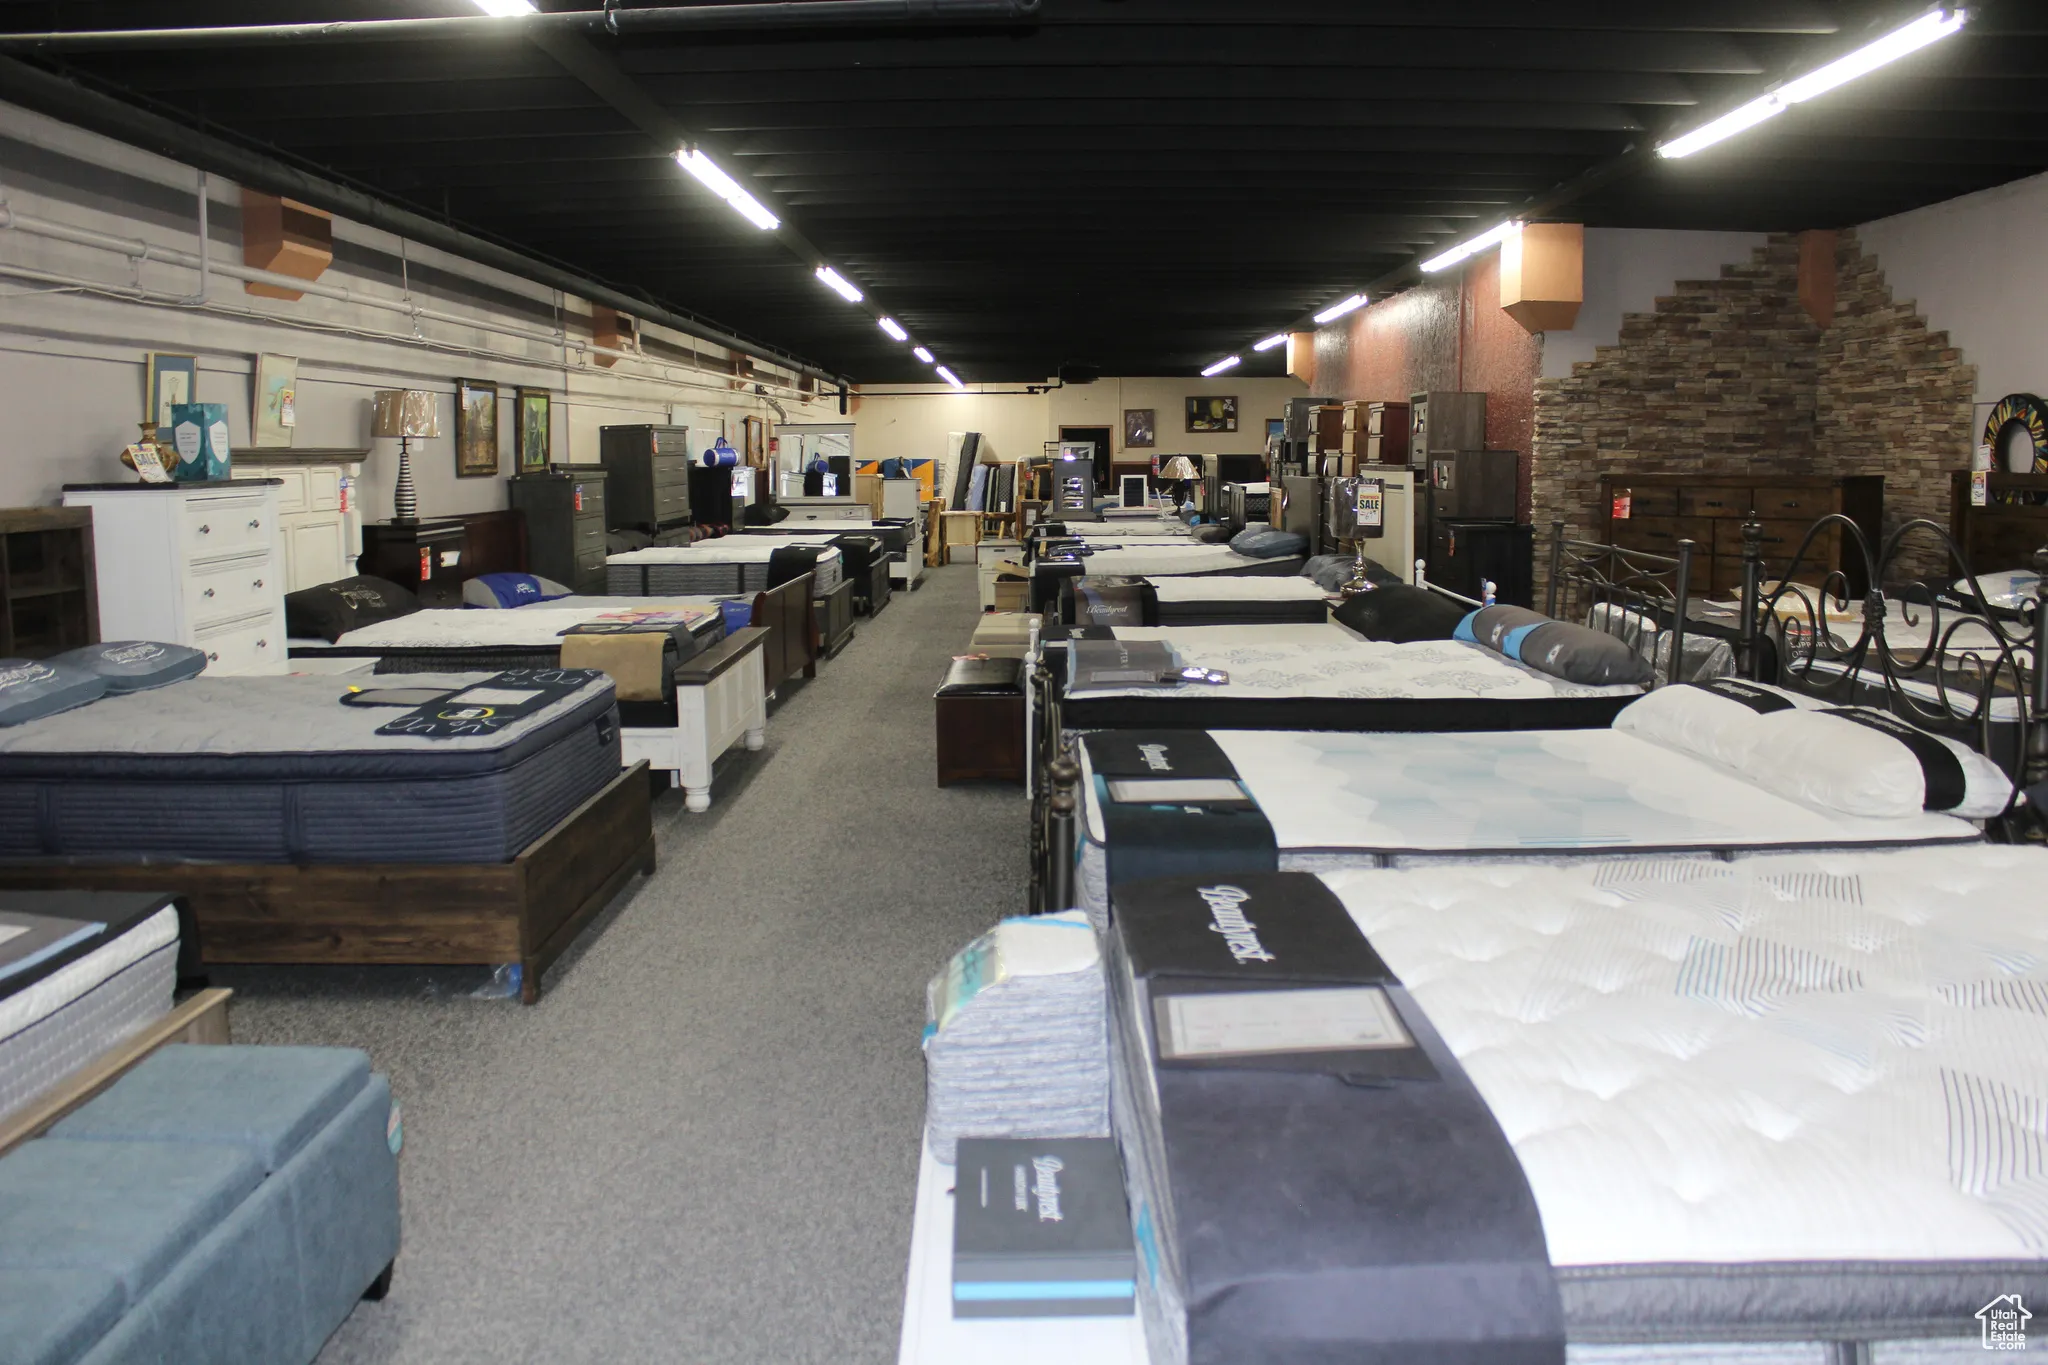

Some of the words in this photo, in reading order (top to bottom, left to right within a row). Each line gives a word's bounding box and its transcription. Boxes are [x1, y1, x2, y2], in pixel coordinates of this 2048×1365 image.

[134, 453, 158, 466] SALE
[1359, 499, 1380, 509] SALE
[1196, 885, 1277, 963] Beautyrest
